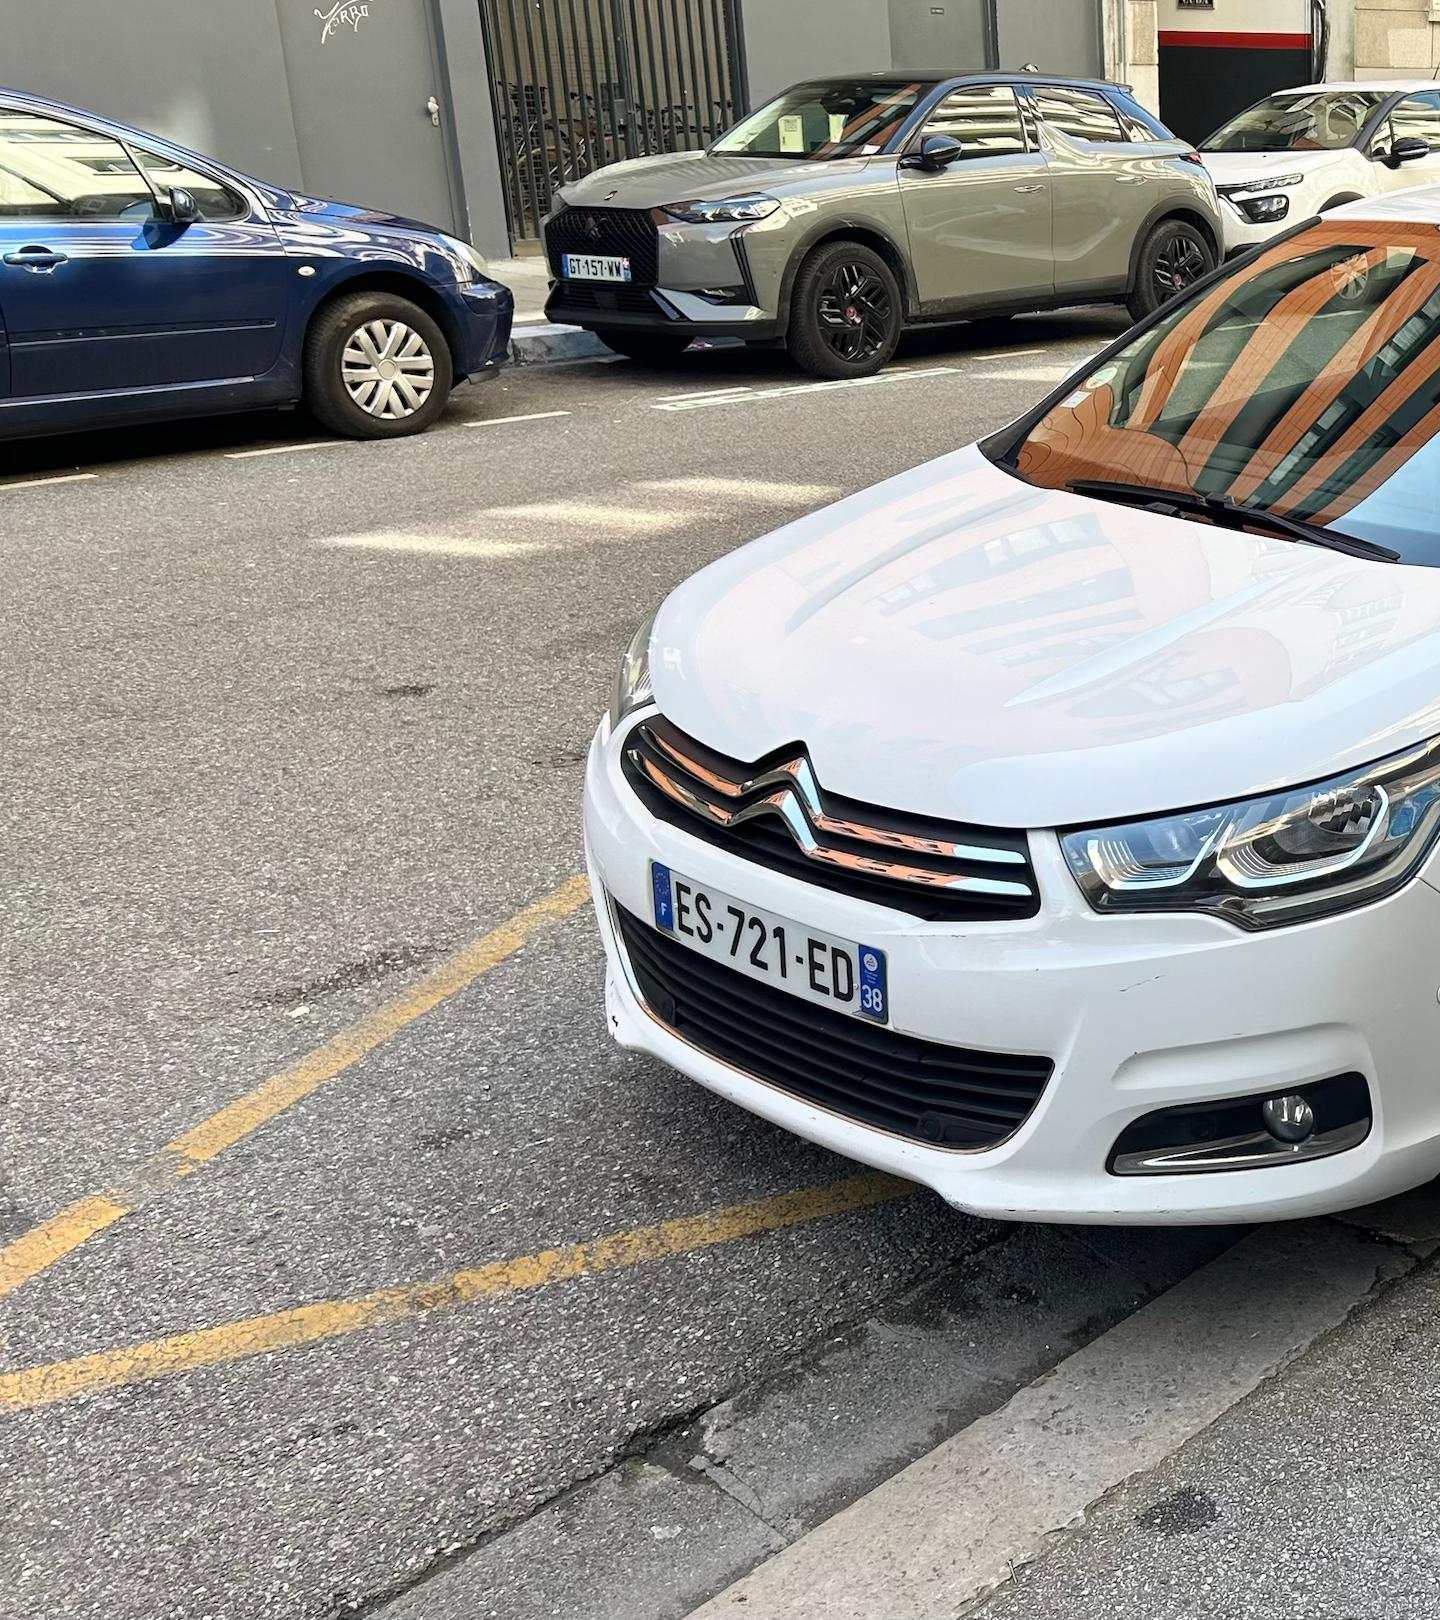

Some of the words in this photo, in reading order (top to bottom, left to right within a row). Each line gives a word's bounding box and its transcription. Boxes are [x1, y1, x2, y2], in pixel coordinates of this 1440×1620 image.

[569, 258, 621, 277] GT-157-WW
[661, 902, 668, 916] F
[675, 881, 854, 1002] ES-721-ED
[862, 984, 883, 1012] 38
